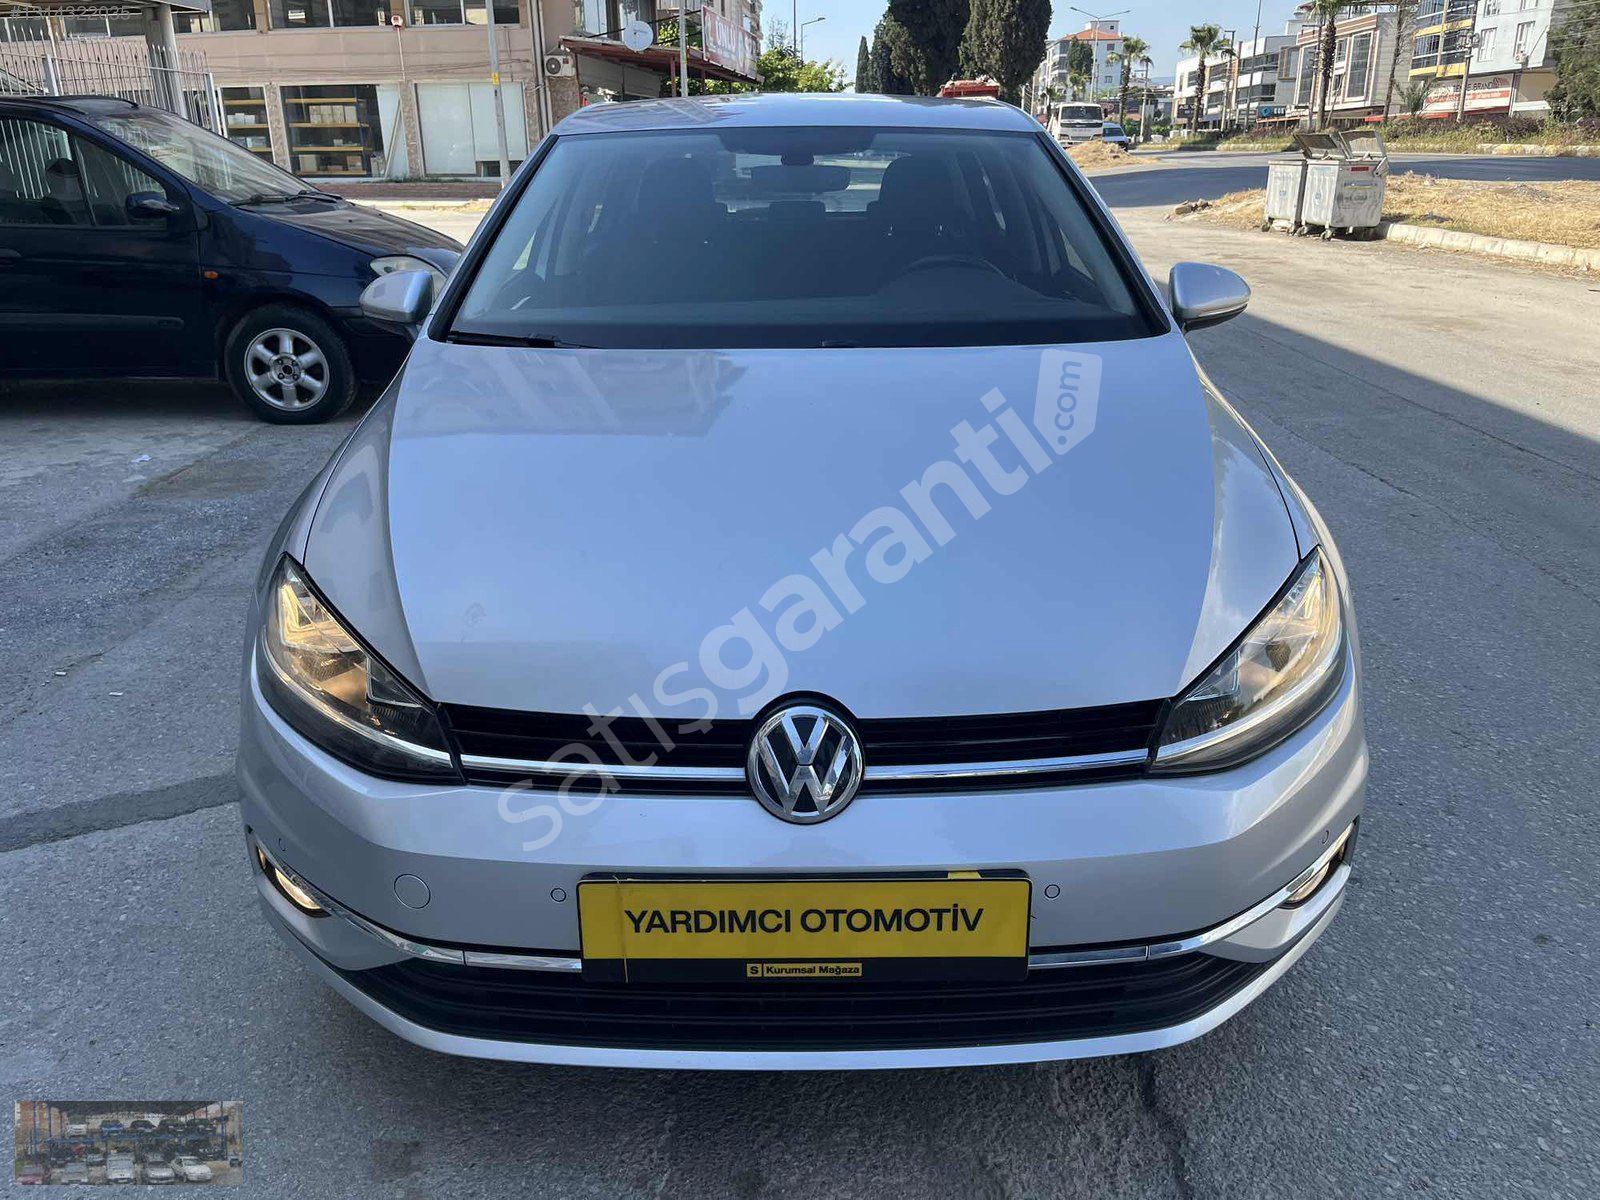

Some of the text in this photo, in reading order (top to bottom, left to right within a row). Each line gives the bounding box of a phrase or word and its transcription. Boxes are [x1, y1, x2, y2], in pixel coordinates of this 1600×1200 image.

[624, 903, 984, 933] YARDIMCI OTOMOTİV
[750, 965, 860, 976] S Kurumsal Mağaza
